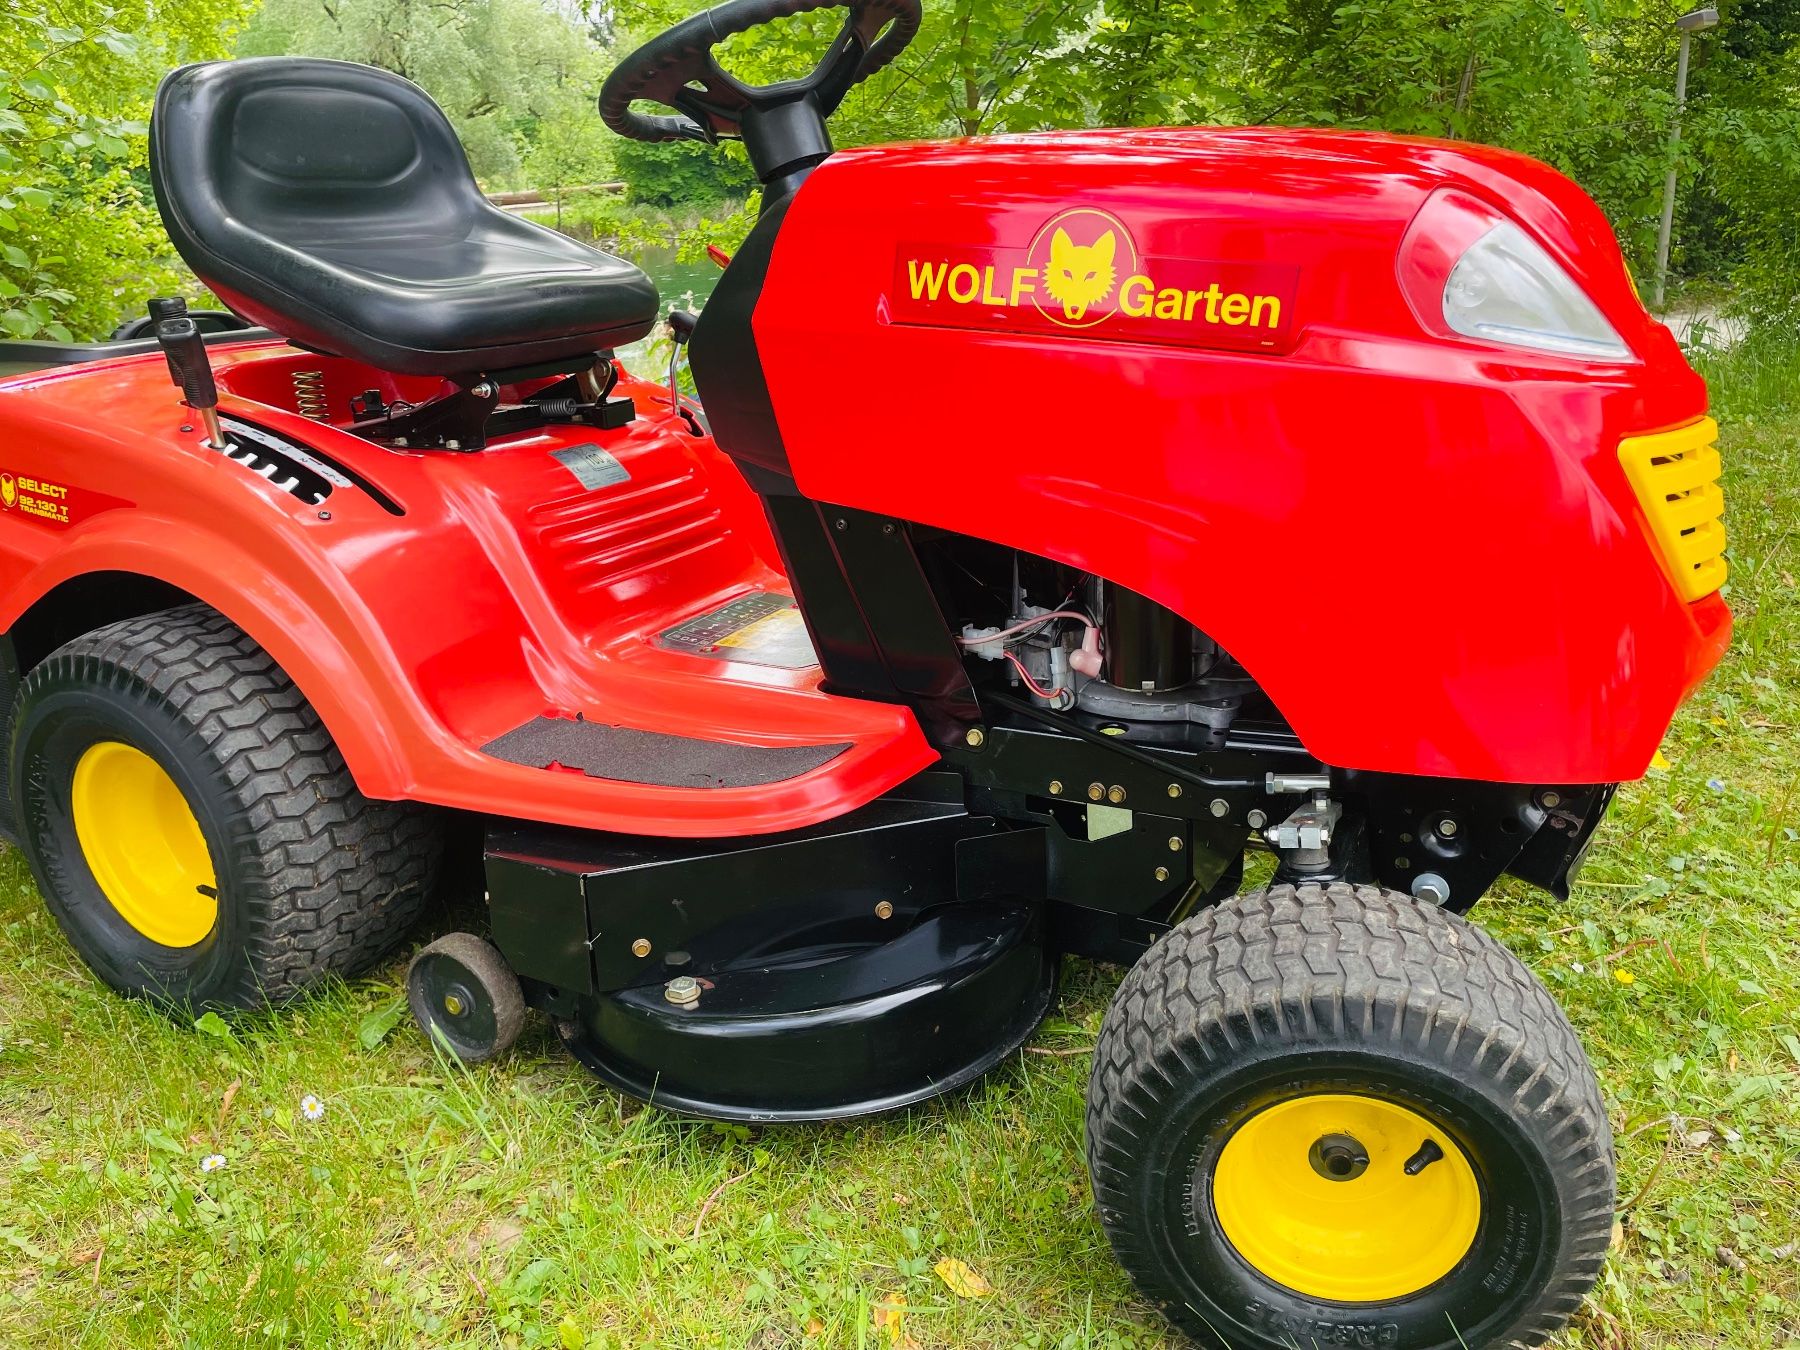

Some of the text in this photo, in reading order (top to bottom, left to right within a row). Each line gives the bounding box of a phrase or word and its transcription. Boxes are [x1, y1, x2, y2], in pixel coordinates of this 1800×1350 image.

[908, 261, 1281, 328] WOLF Garten
[18, 476, 68, 500] SELECT
[19, 494, 69, 516] 92.130 T
[19, 504, 69, 523] TRANSMATIC
